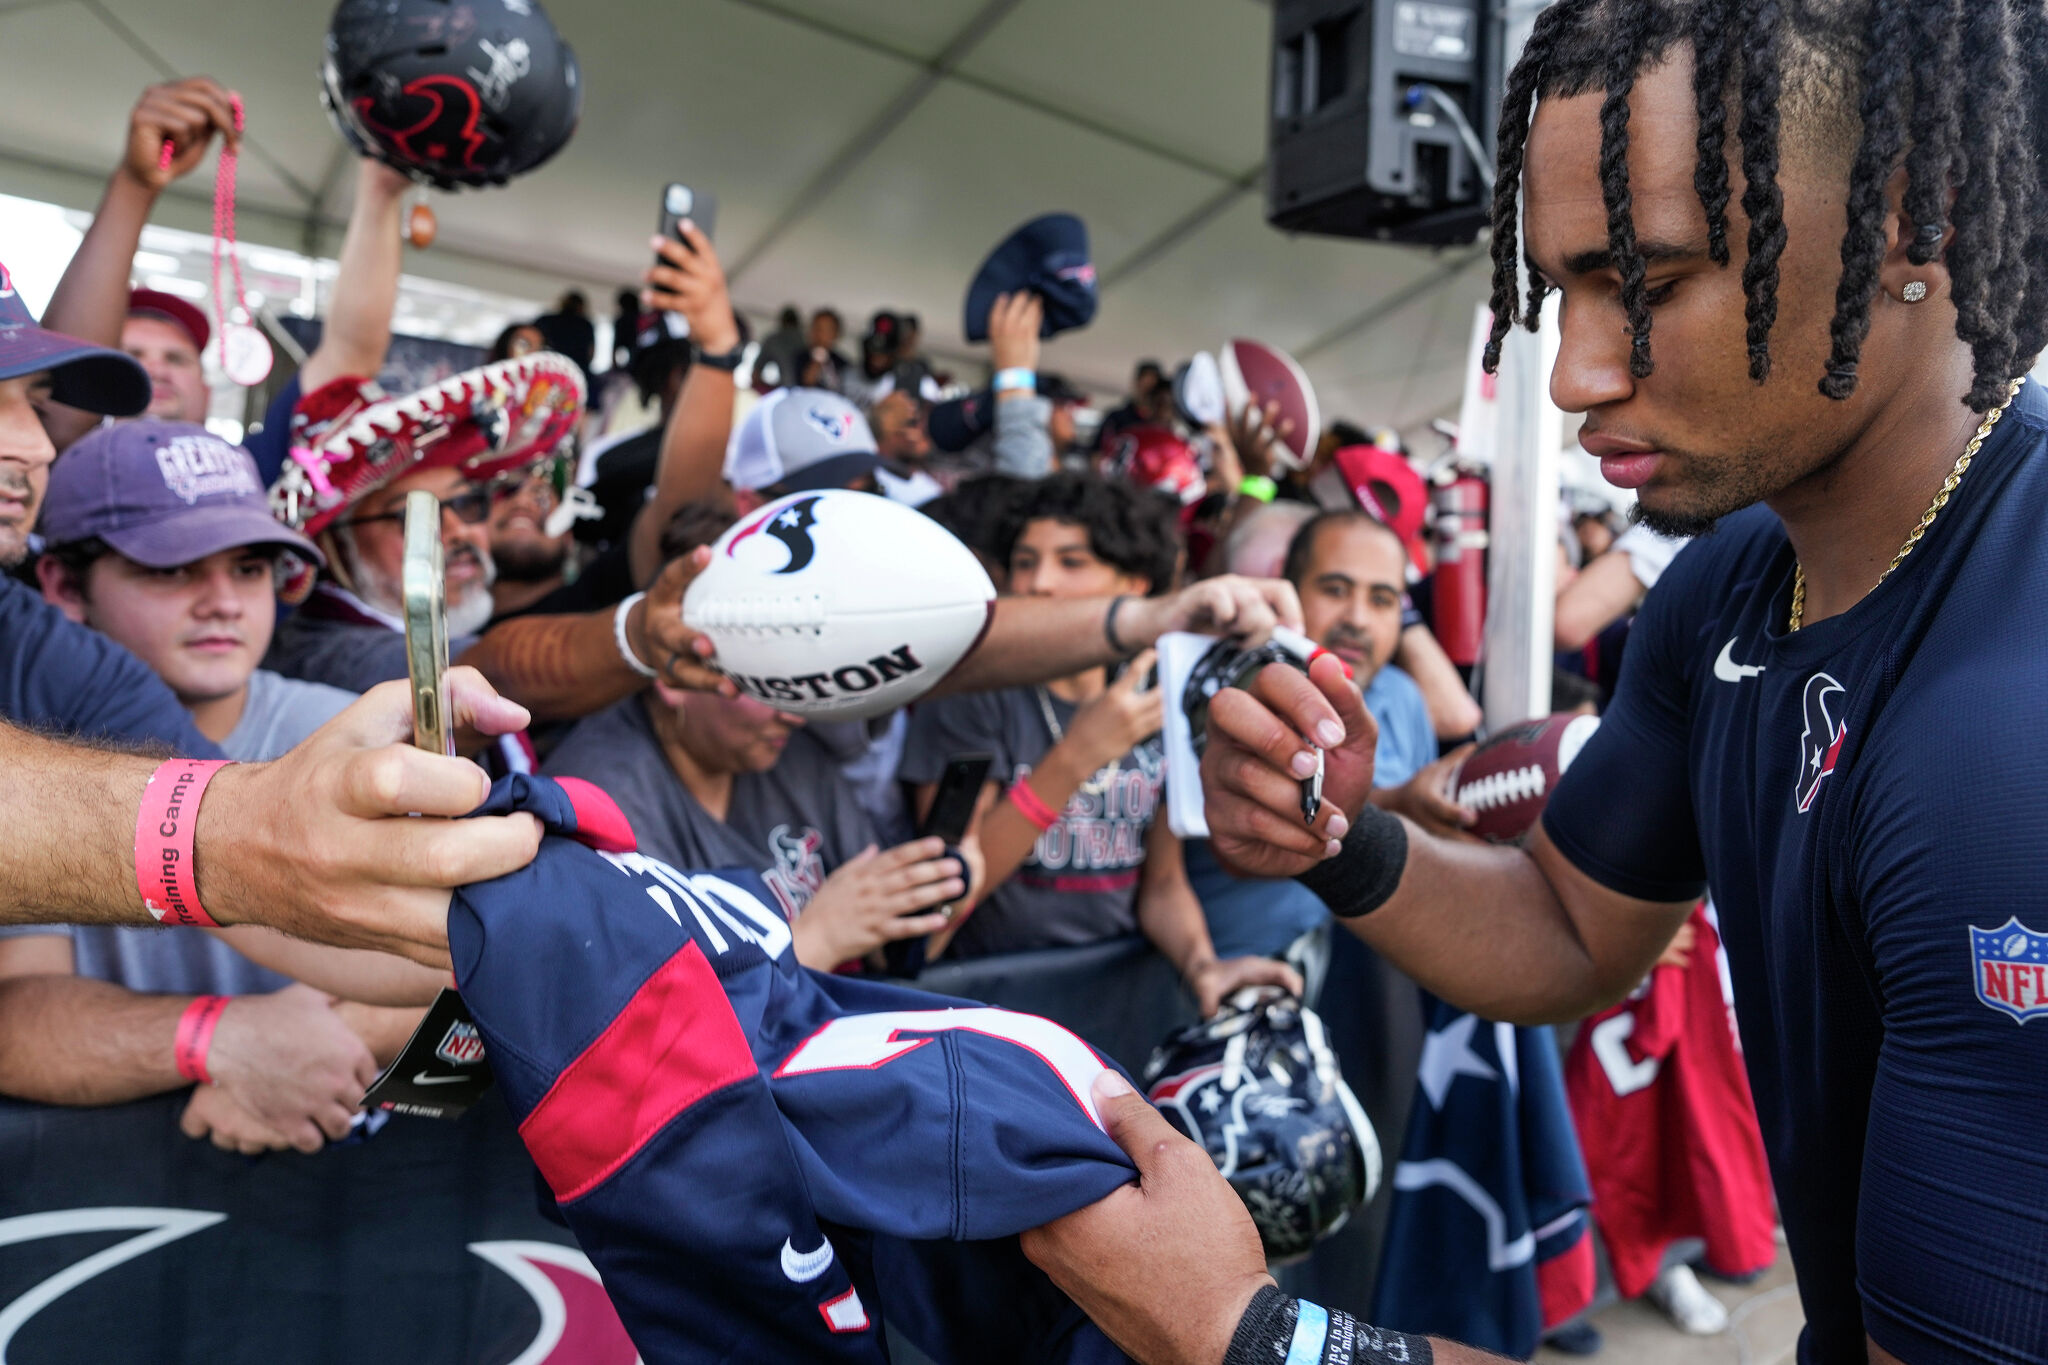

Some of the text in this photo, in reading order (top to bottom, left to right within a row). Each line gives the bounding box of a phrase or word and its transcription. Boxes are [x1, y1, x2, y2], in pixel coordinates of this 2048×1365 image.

[159, 772, 199, 926] Training Camp
[1982, 960, 2048, 1010] NFL
[1329, 1328, 1342, 1341] in
[1331, 1312, 1343, 1327] the
[1340, 1318, 1356, 1351] mighty
